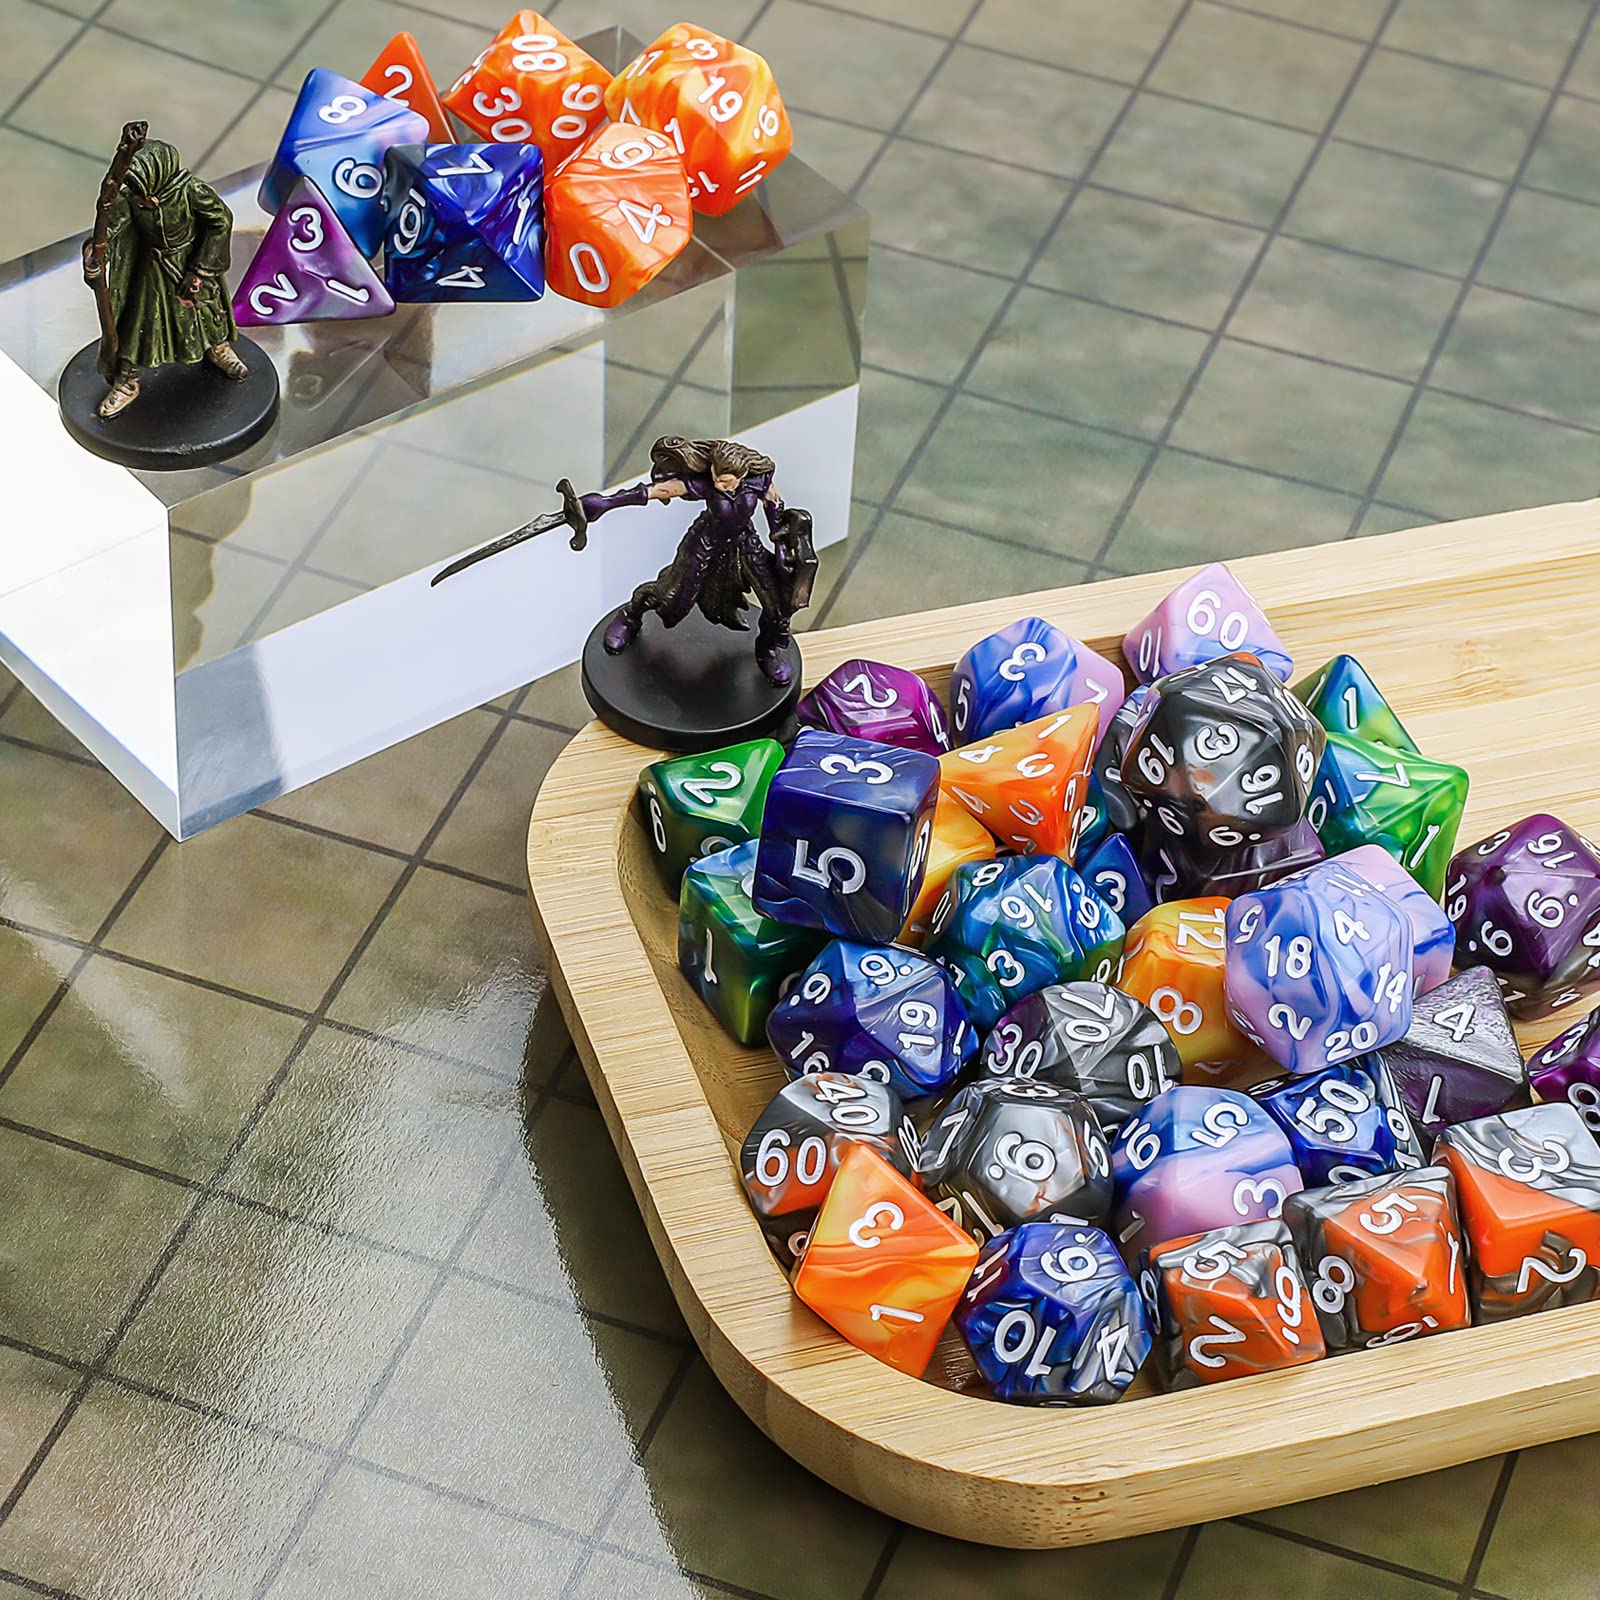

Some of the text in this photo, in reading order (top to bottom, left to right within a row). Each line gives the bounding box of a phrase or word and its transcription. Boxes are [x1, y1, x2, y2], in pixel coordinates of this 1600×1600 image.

[510, 33, 568, 72] 80
[685, 38, 718, 61] 3
[383, 64, 412, 107] 2
[697, 76, 743, 123] 19
[318, 95, 367, 124] 8
[472, 86, 532, 143] 30
[663, 117, 685, 155] 1
[734, 160, 768, 195] 11
[288, 207, 324, 251] 3
[514, 197, 531, 245] 1
[617, 198, 672, 245] 4
[434, 265, 487, 289] 4
[568, 242, 610, 293] 0
[249, 273, 299, 315] 2
[327, 279, 370, 303] 1
[1186, 589, 1249, 651] 60
[998, 641, 1047, 682] 3
[842, 673, 898, 709] 2
[954, 677, 972, 732] 5
[1342, 686, 1358, 730] 1
[1037, 714, 1073, 739] 1
[1196, 723, 1240, 762] 3
[818, 752, 895, 786] 3
[957, 744, 1004, 765] 4
[1015, 752, 1055, 779] 3
[1137, 733, 1176, 785] 19
[1295, 743, 1316, 784] 8
[682, 761, 742, 804] 2
[951, 785, 992, 815] 4
[1240, 763, 1284, 816] 16
[1409, 824, 1441, 870] 1
[1477, 830, 1512, 856] 3
[791, 839, 867, 895] 5
[971, 862, 1005, 889] 8
[1000, 883, 1054, 929] 16
[1095, 870, 1127, 914] 3
[1447, 875, 1468, 922] 19
[1233, 903, 1265, 945] 5
[1333, 909, 1371, 945] 4
[703, 927, 718, 985] 1
[986, 949, 1026, 988] 3
[1263, 934, 1314, 980] 18
[1150, 985, 1203, 1036] 8
[1373, 962, 1408, 1014] 14
[897, 999, 939, 1050] 19
[1060, 990, 1116, 1044] 70
[1267, 1003, 1313, 1042] 2
[1432, 1002, 1475, 1043] 4
[986, 1022, 1045, 1080] 30
[1324, 1020, 1379, 1063] 20
[1541, 1022, 1591, 1065] 3
[1126, 1043, 1176, 1101] 10
[815, 1078, 880, 1126] 40
[1295, 1078, 1371, 1144] 50
[1421, 1074, 1443, 1126] 1
[1567, 1082, 1600, 1132] 8
[1191, 1101, 1249, 1149] 5
[755, 1128, 827, 1187] 60
[1496, 1137, 1571, 1185] 3
[1232, 1177, 1288, 1219] 3
[1358, 1191, 1419, 1235] 5
[847, 1200, 906, 1249] 3
[966, 1242, 1009, 1303] 11
[1181, 1239, 1249, 1280] 5
[1515, 1247, 1588, 1295] 2
[1311, 1254, 1356, 1315] 8
[869, 1303, 926, 1323] 1
[993, 1308, 1058, 1378] 10
[1095, 1323, 1135, 1381] 4
[1188, 1314, 1248, 1370] 2
